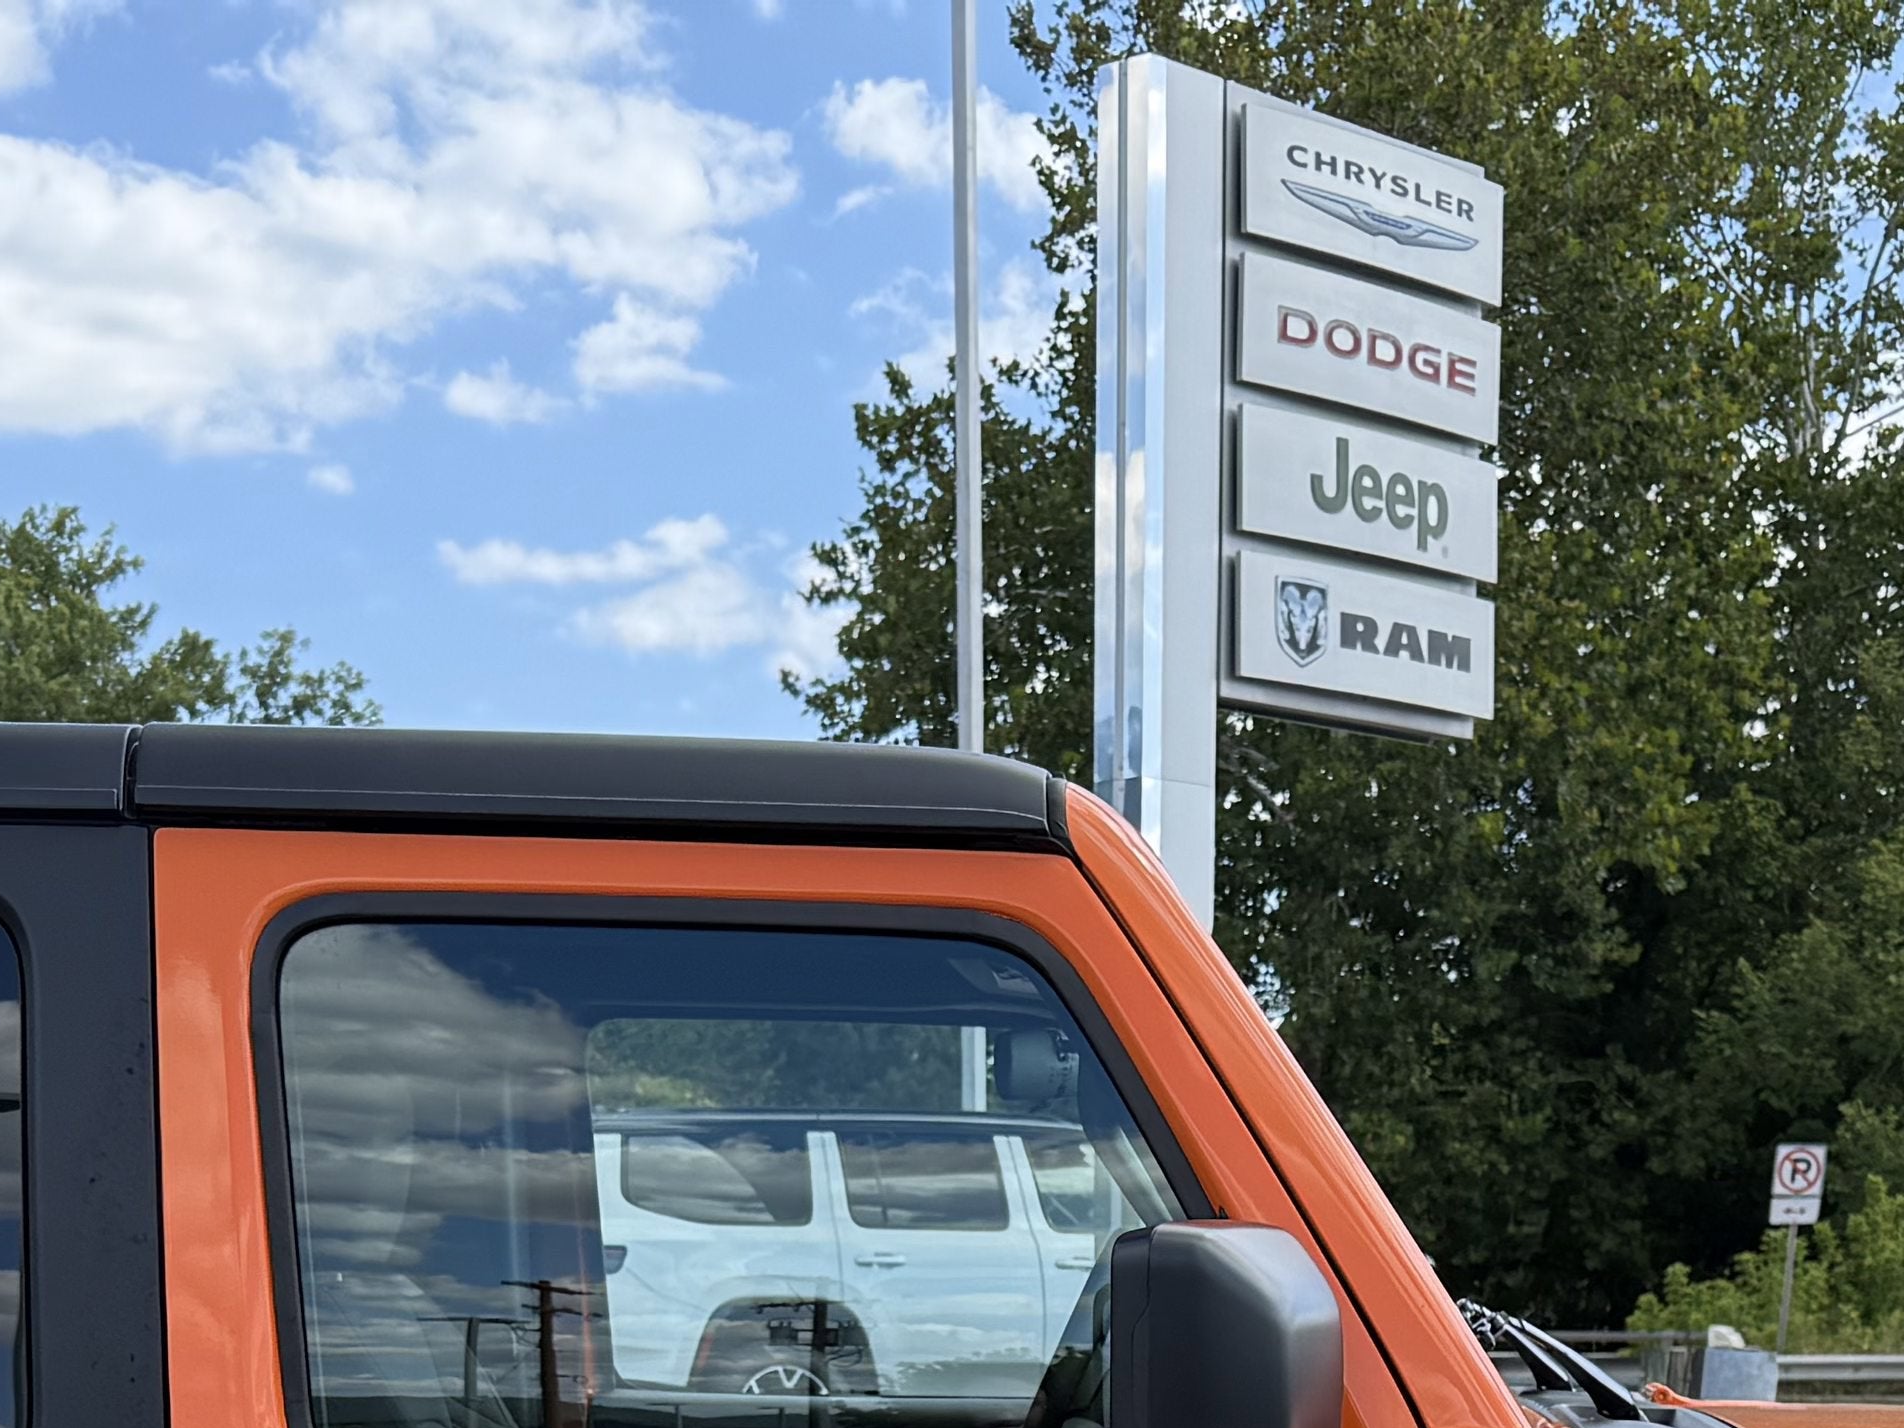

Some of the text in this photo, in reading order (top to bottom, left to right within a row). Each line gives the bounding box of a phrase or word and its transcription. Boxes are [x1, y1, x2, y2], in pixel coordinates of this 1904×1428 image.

[1286, 144, 1476, 222] CHRYSLER
[1277, 304, 1477, 396] DODGE
[1310, 437, 1449, 552] Jeep
[1339, 611, 1472, 673] RAM
